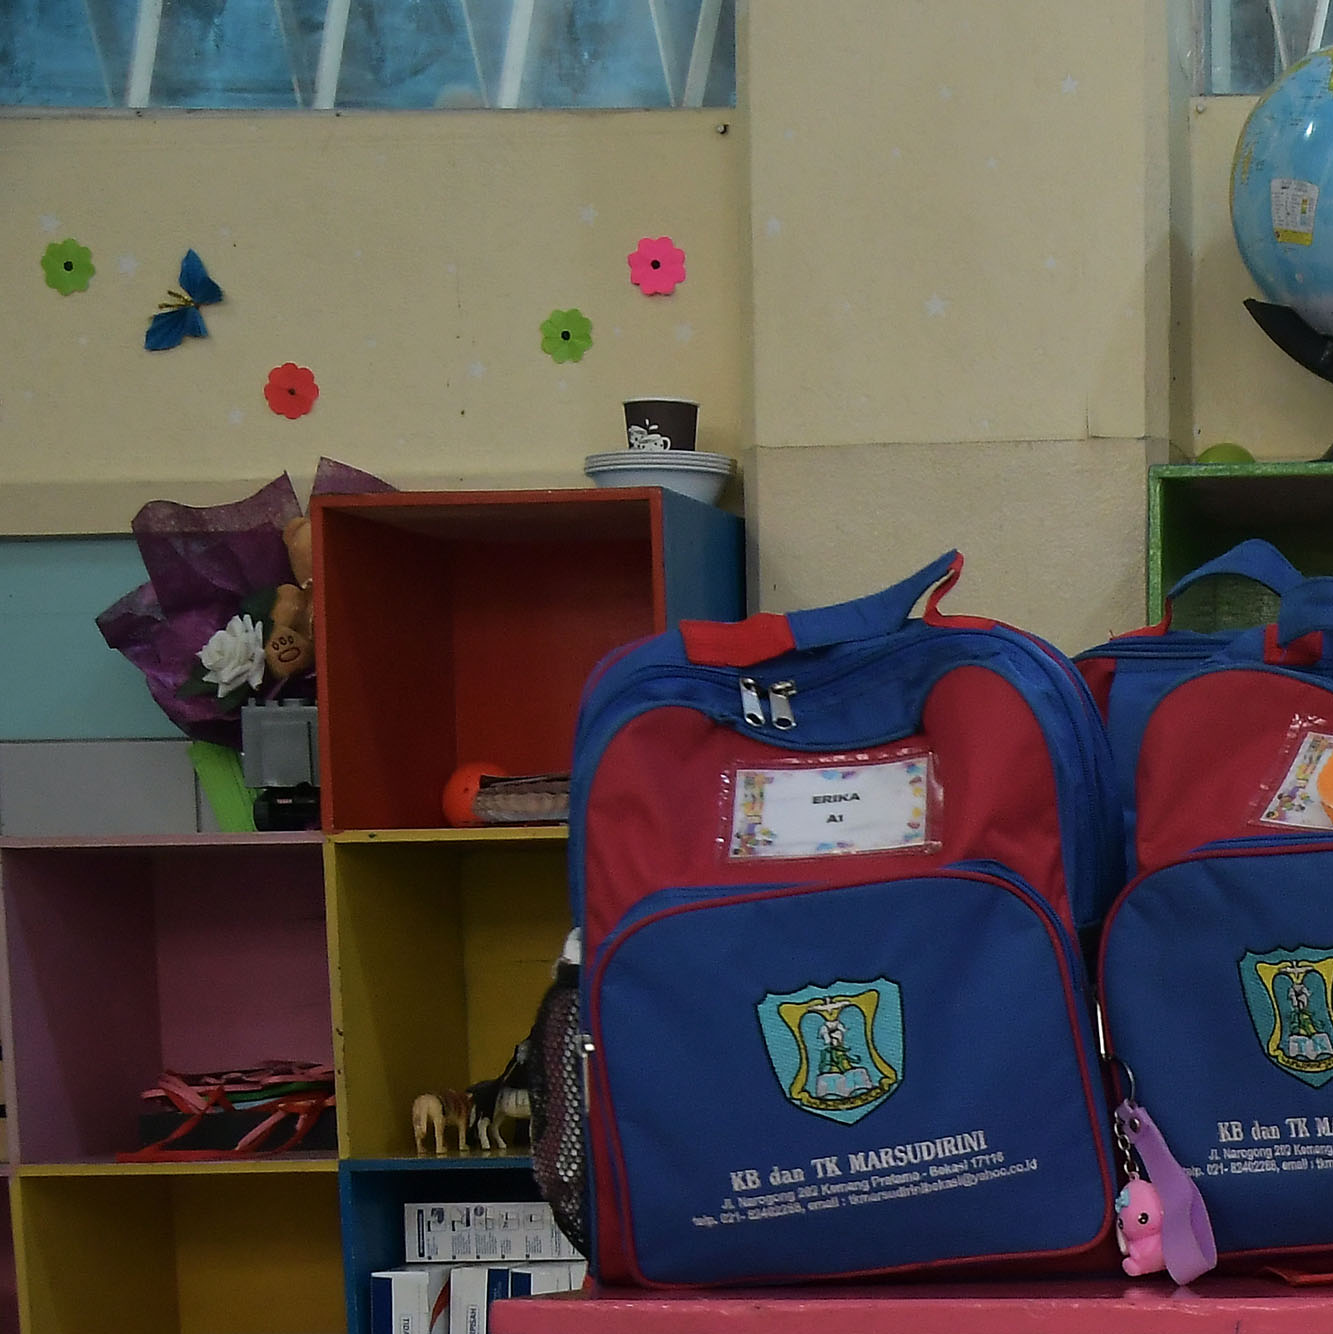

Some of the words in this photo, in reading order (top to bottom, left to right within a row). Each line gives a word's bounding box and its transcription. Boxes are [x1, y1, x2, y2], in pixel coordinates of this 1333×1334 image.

[813, 793, 861, 804] ERIKA
[1217, 1121, 1244, 1143] KB
[1251, 1119, 1280, 1140] dan
[1285, 1117, 1310, 1138] TK
[730, 1169, 762, 1192] KB
[769, 1165, 805, 1186] dan
[811, 1156, 842, 1178] TK
[848, 1130, 988, 1174] MARSUDIRINI
